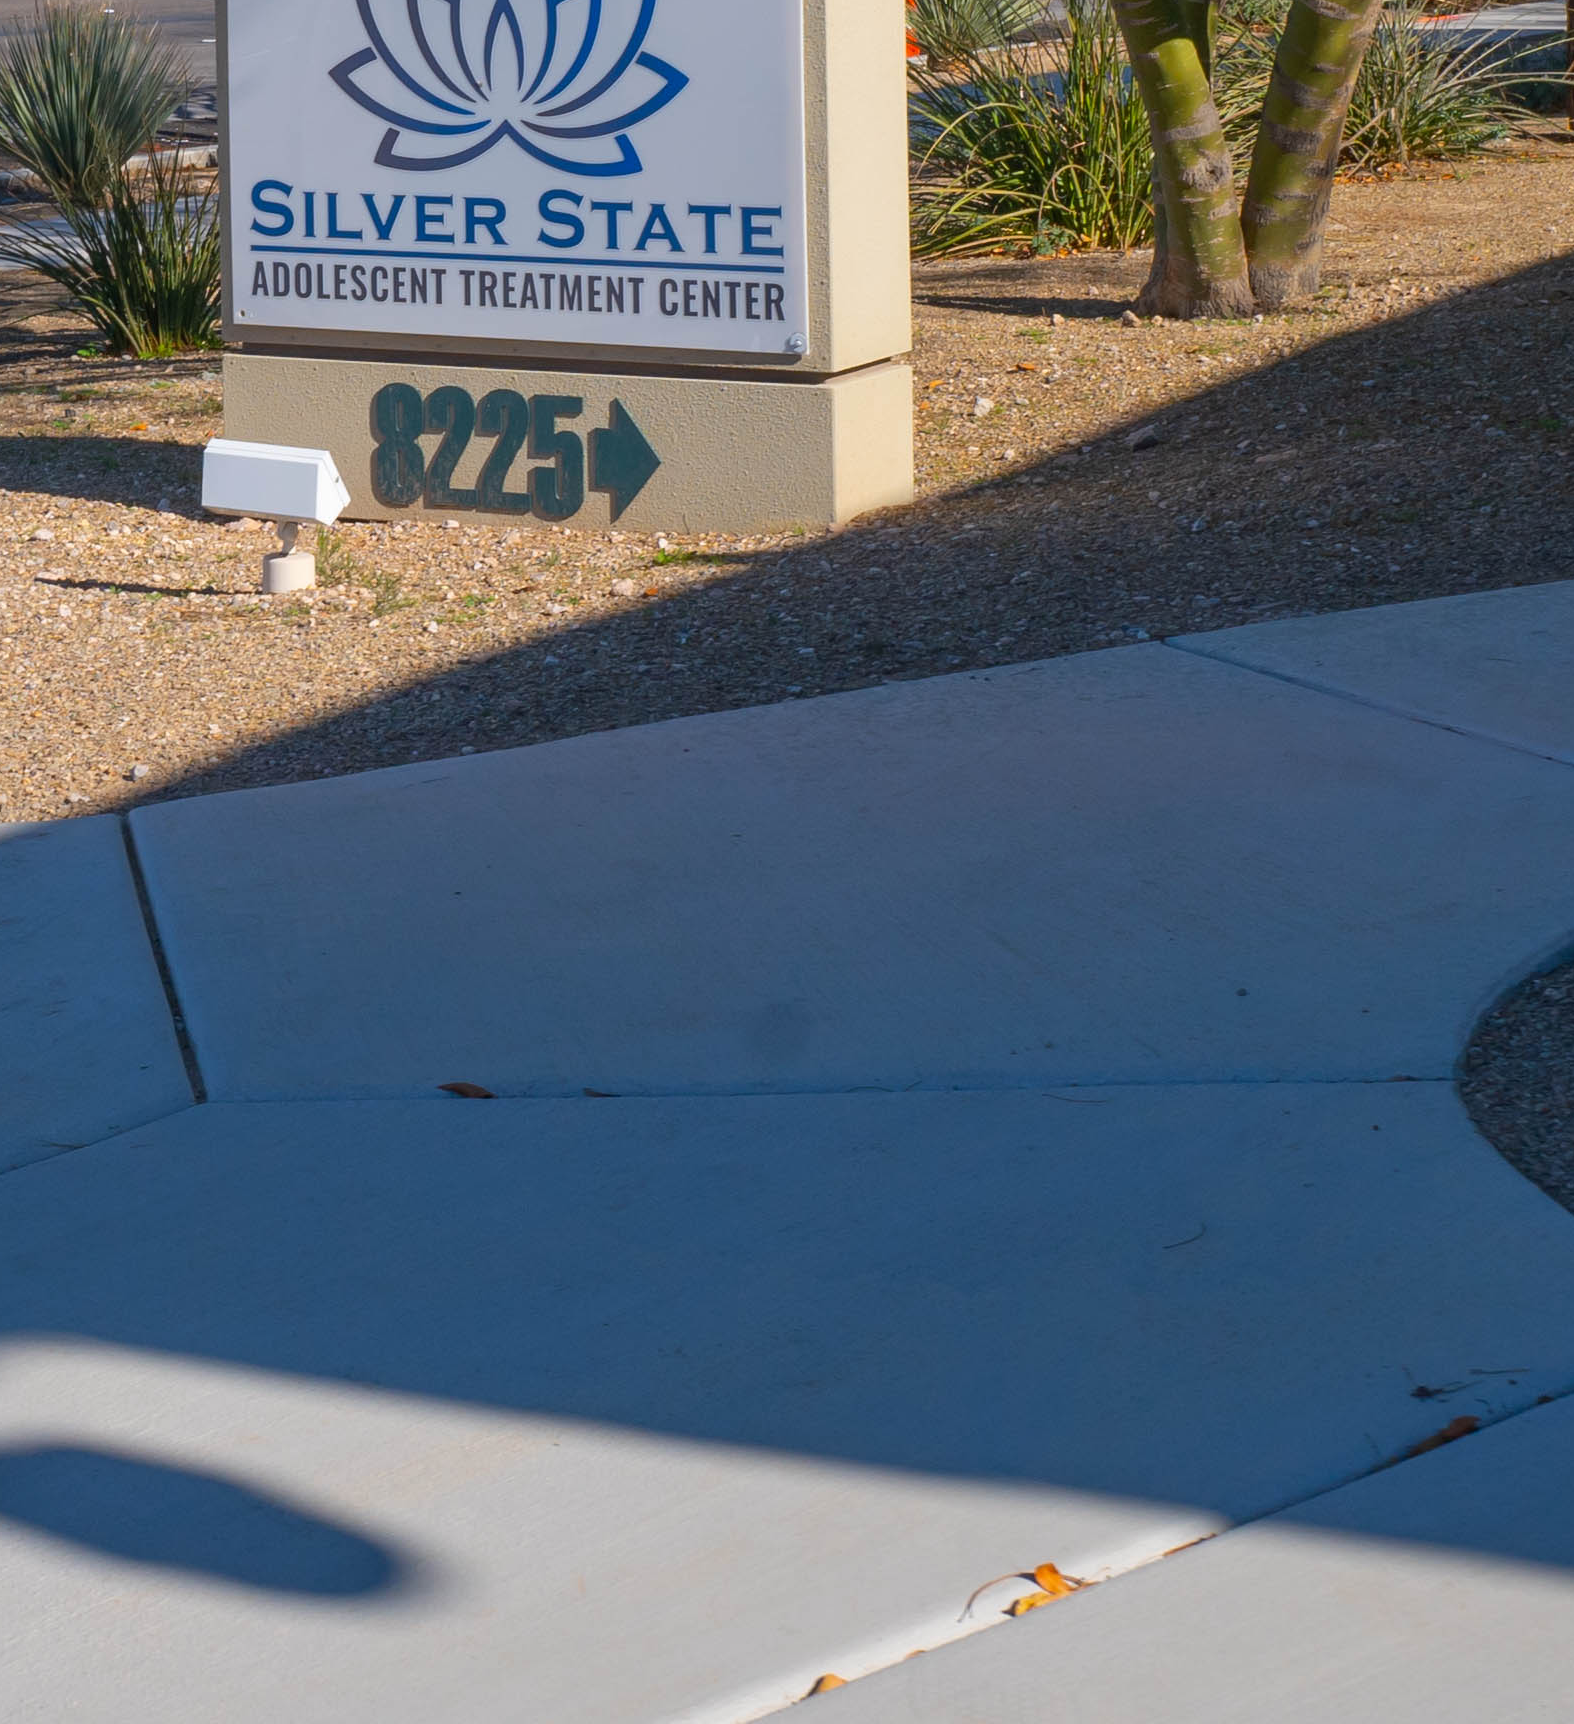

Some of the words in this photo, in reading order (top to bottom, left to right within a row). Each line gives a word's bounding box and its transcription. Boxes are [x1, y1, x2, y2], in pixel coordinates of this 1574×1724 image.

[250, 179, 509, 246] SILVER
[537, 188, 785, 259] STATE
[251, 260, 447, 305] ADOLESCENT
[459, 269, 644, 314] TREATMENT
[659, 278, 786, 321] CENTER
[369, 382, 585, 522] 8225
